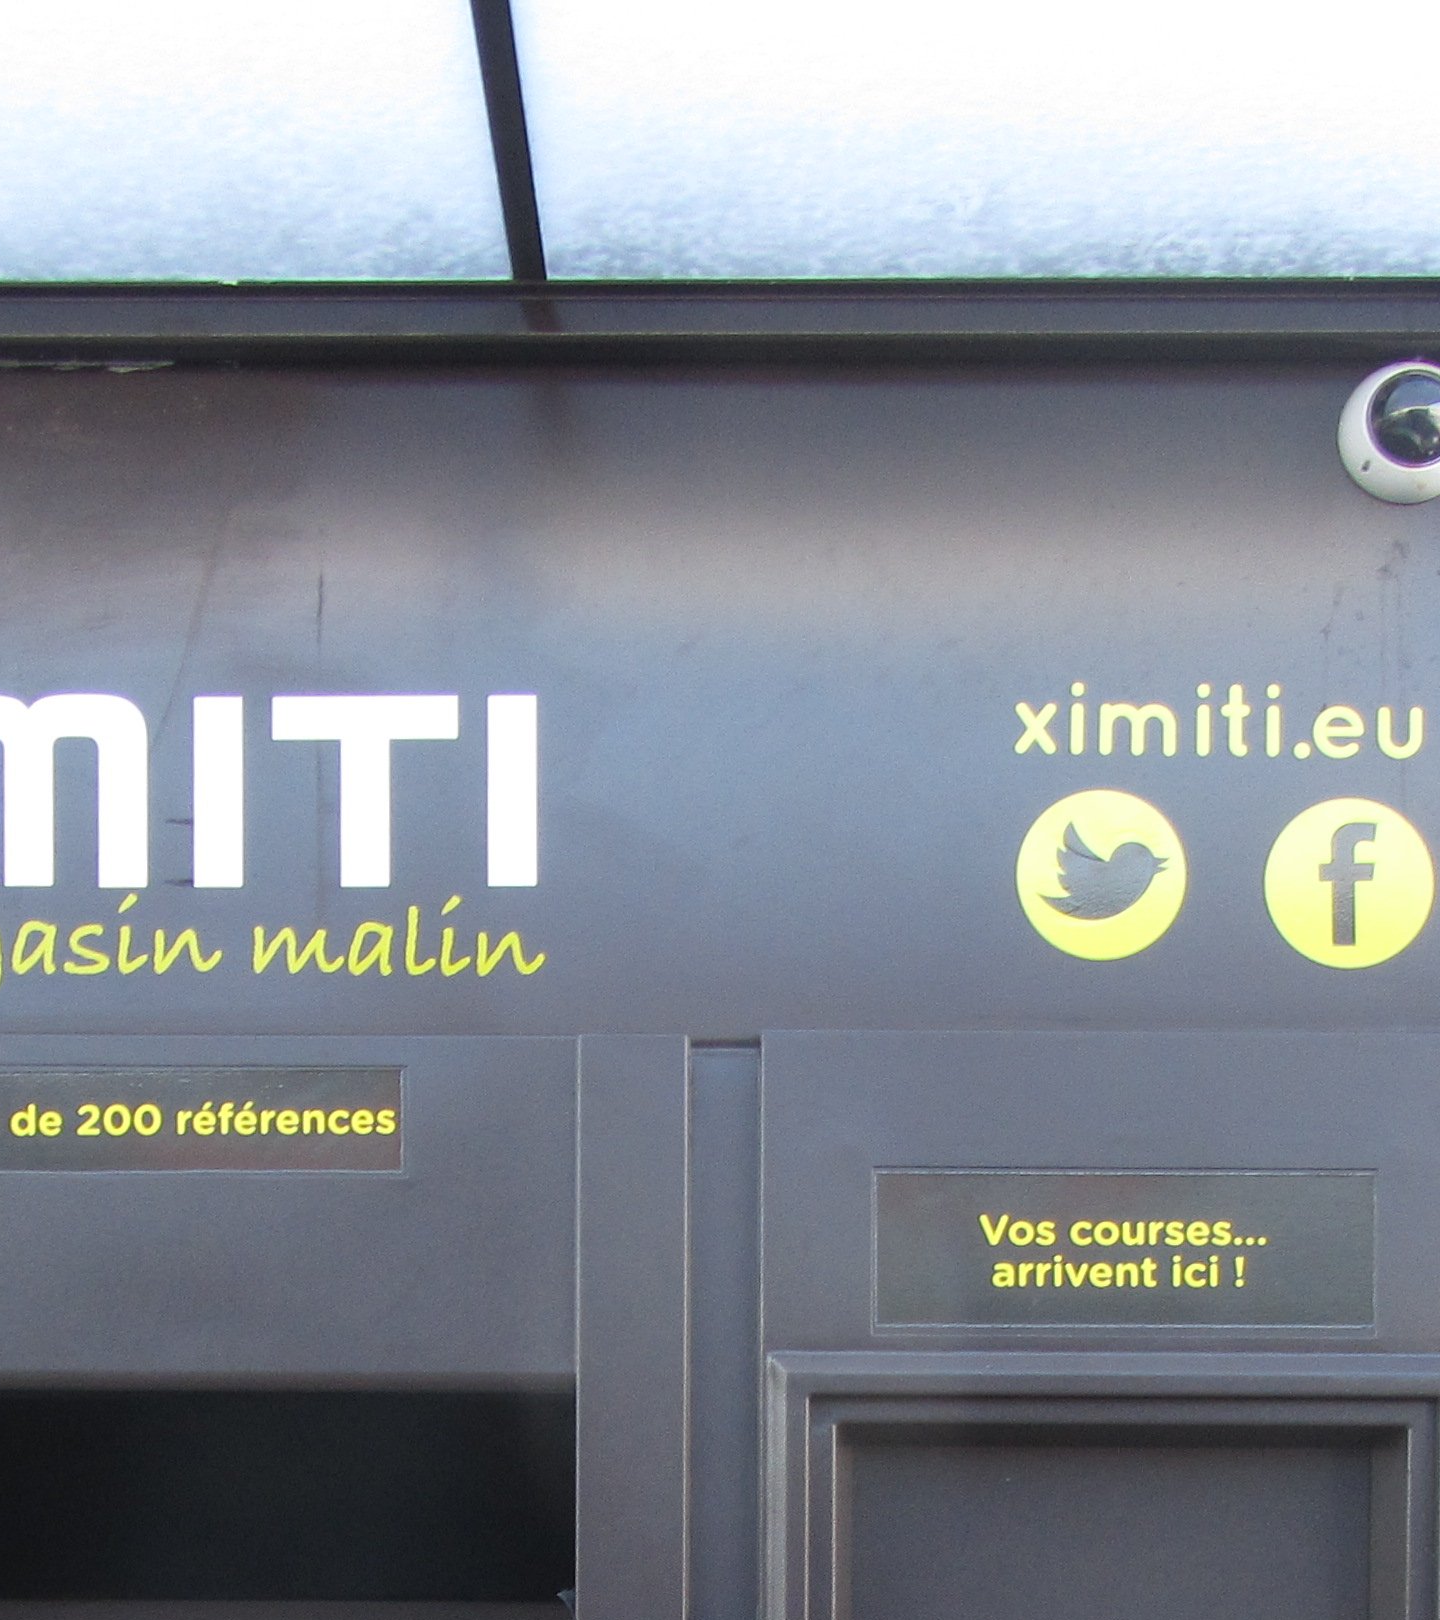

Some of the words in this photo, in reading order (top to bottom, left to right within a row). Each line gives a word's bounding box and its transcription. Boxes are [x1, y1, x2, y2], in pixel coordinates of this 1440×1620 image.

[1013, 682, 1424, 760] ximiti.eu
[253, 895, 547, 978] malin
[9, 1103, 63, 1137] de
[76, 1103, 162, 1137] 200
[176, 1100, 397, 1136] références
[979, 1214, 1056, 1246] Vos
[1069, 1216, 1268, 1247] courses...
[992, 1256, 1158, 1289] arrivent
[1172, 1256, 1220, 1289] ici
